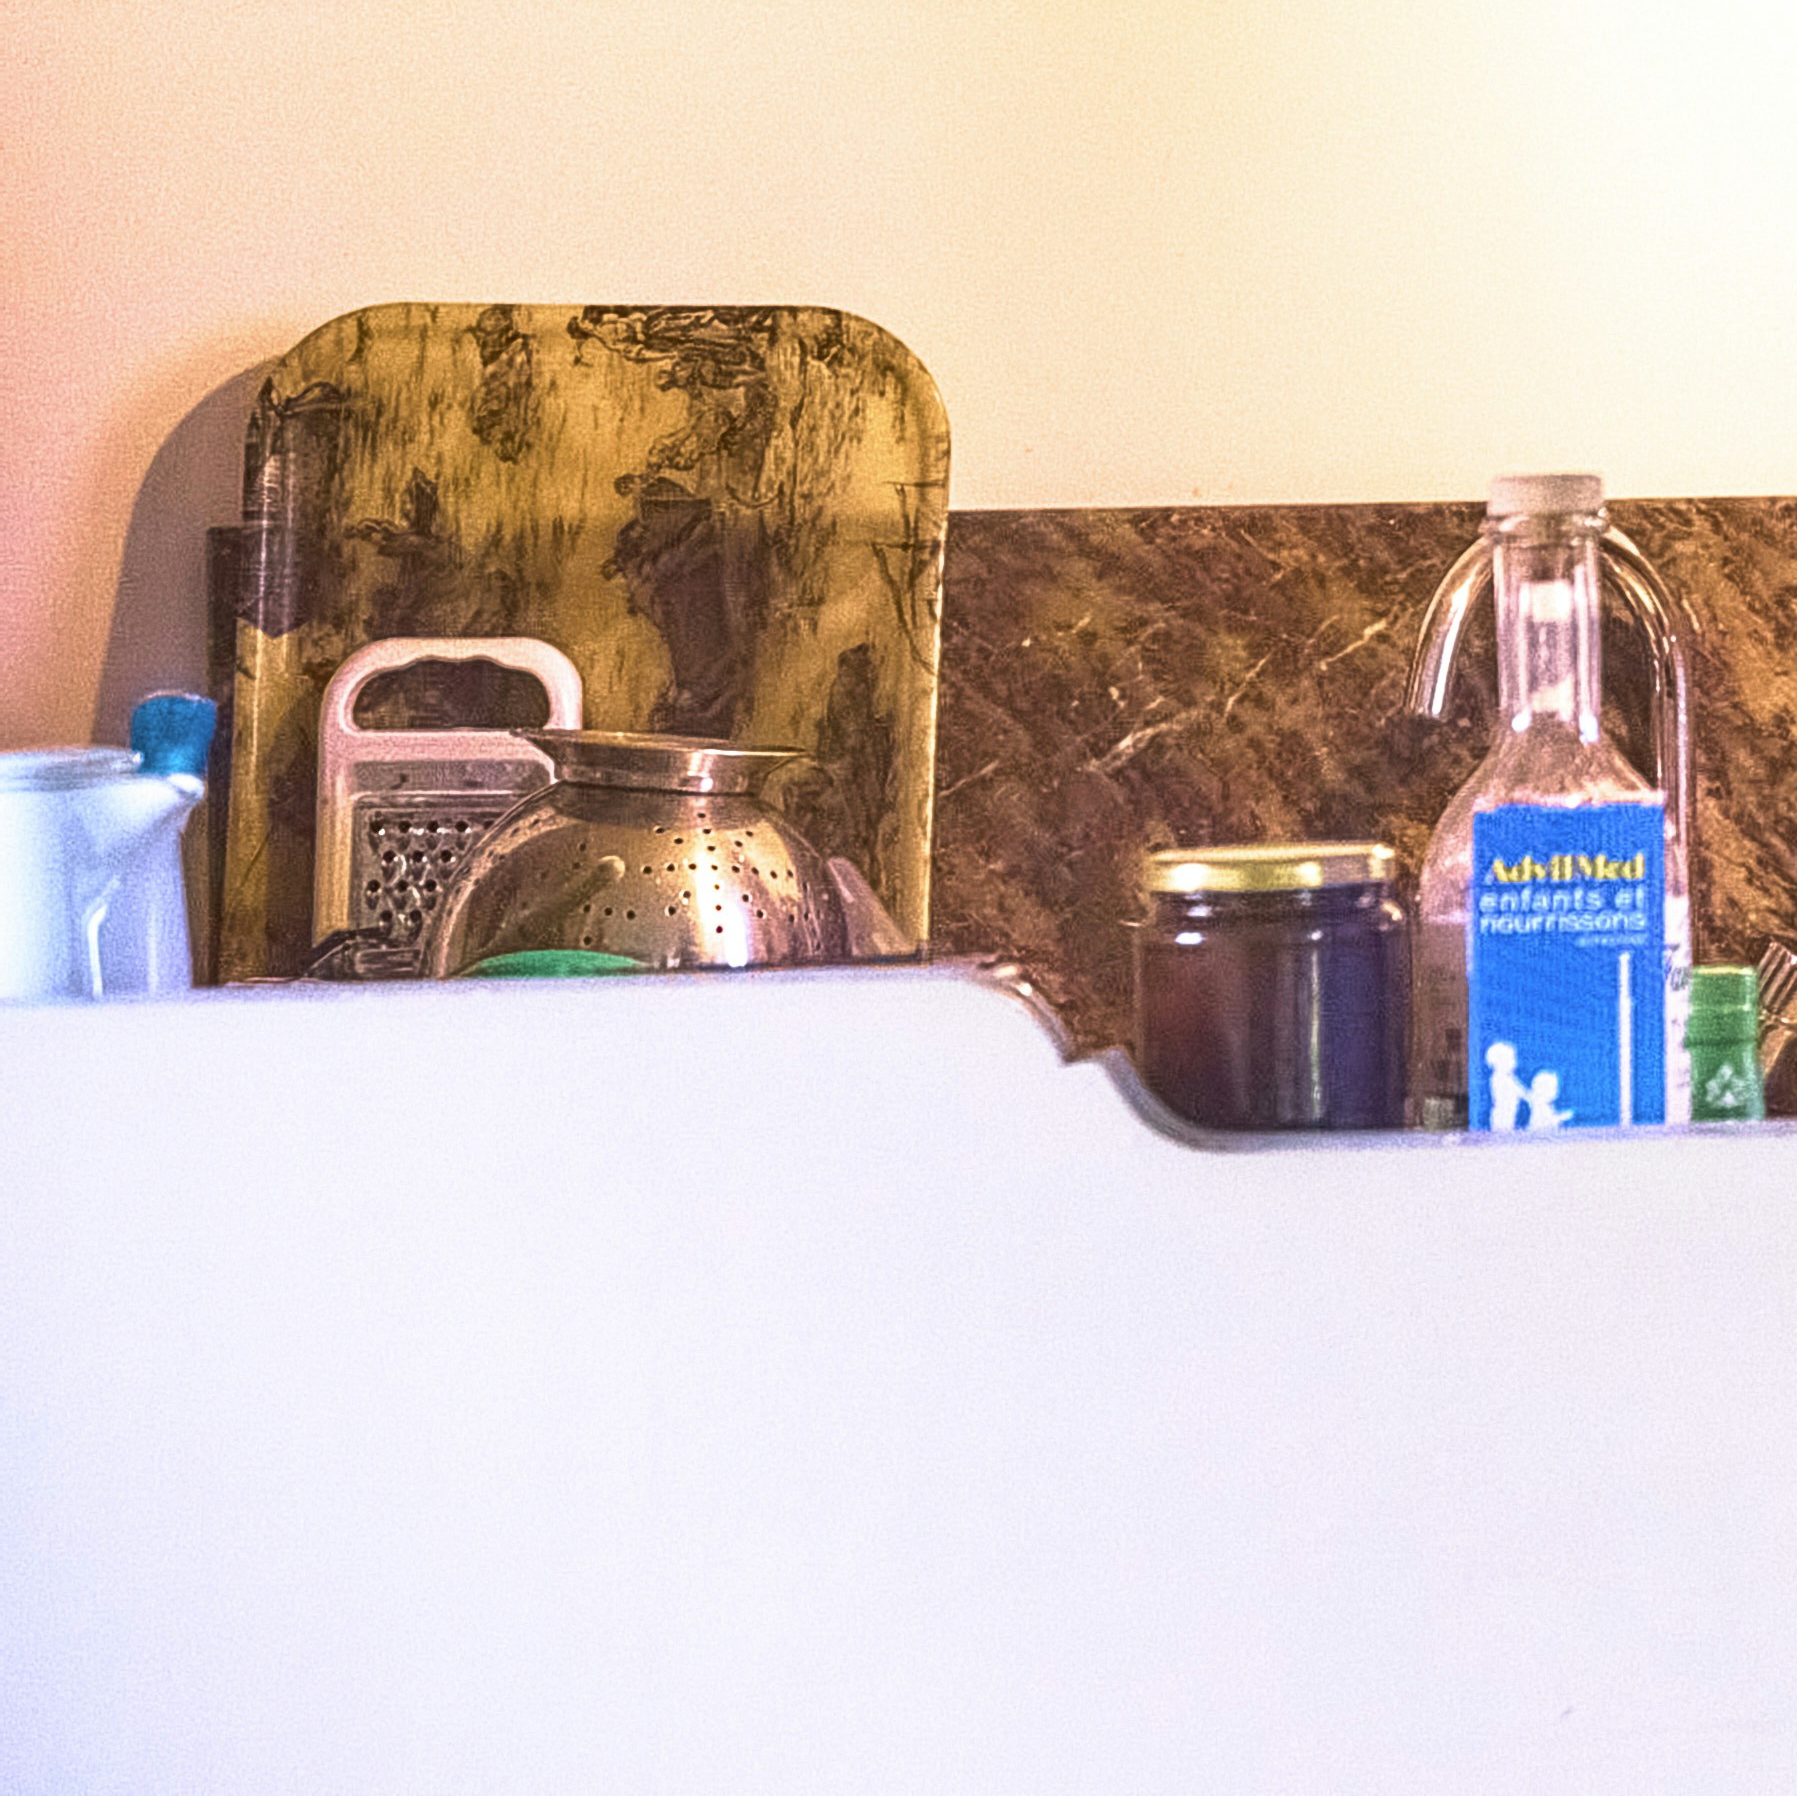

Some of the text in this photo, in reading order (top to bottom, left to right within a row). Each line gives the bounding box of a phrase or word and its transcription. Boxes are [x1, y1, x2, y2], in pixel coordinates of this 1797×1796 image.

[1479, 886, 1645, 912] enfants et
[1479, 910, 1647, 934] nourrissons
